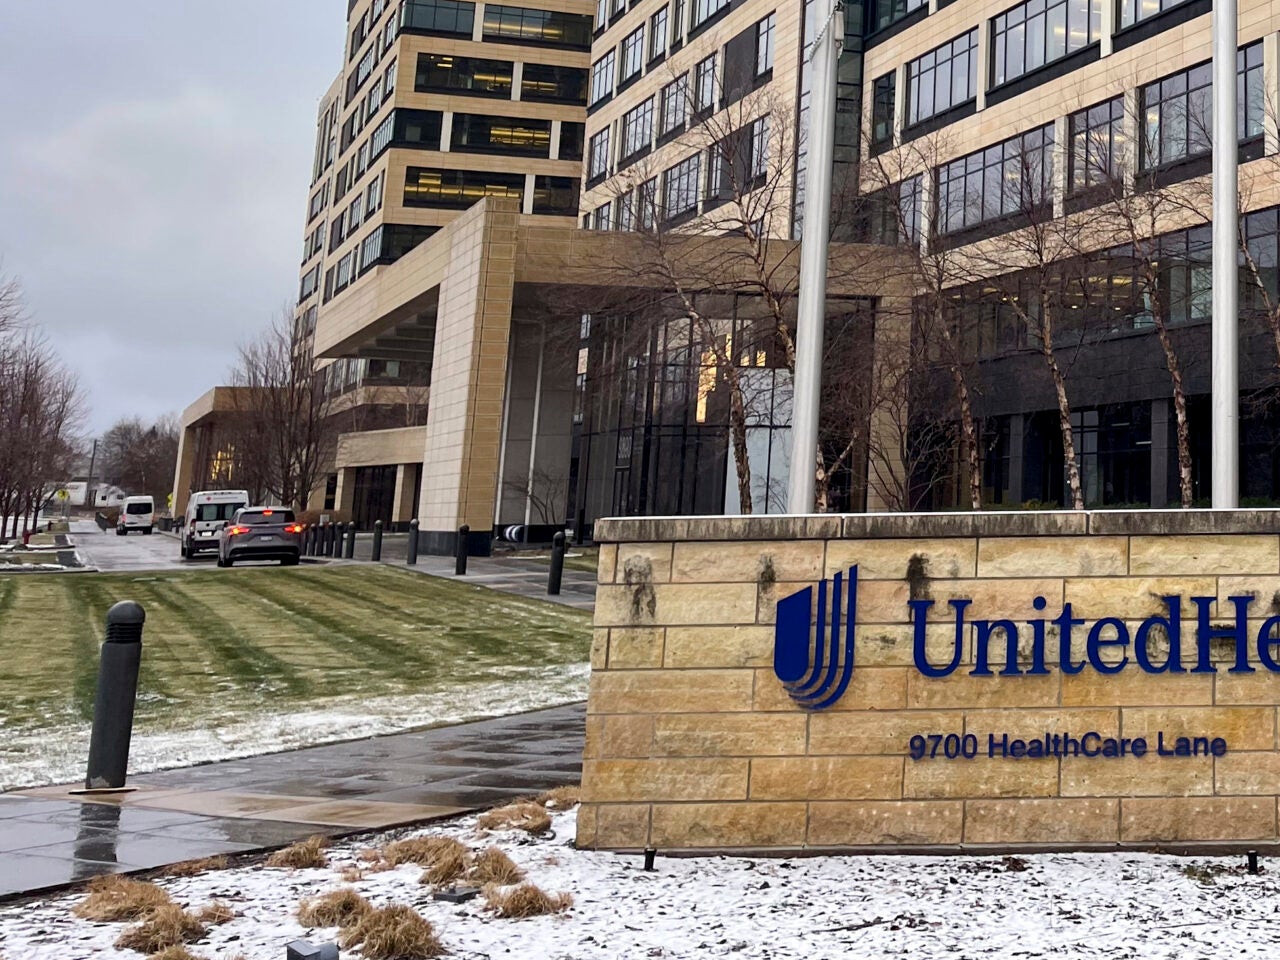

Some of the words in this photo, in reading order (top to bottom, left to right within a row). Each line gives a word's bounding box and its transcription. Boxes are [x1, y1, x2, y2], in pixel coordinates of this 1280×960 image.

[910, 734, 977, 760] 9700
[988, 732, 1147, 758] HealthCare
[1156, 731, 1227, 758] Lane
